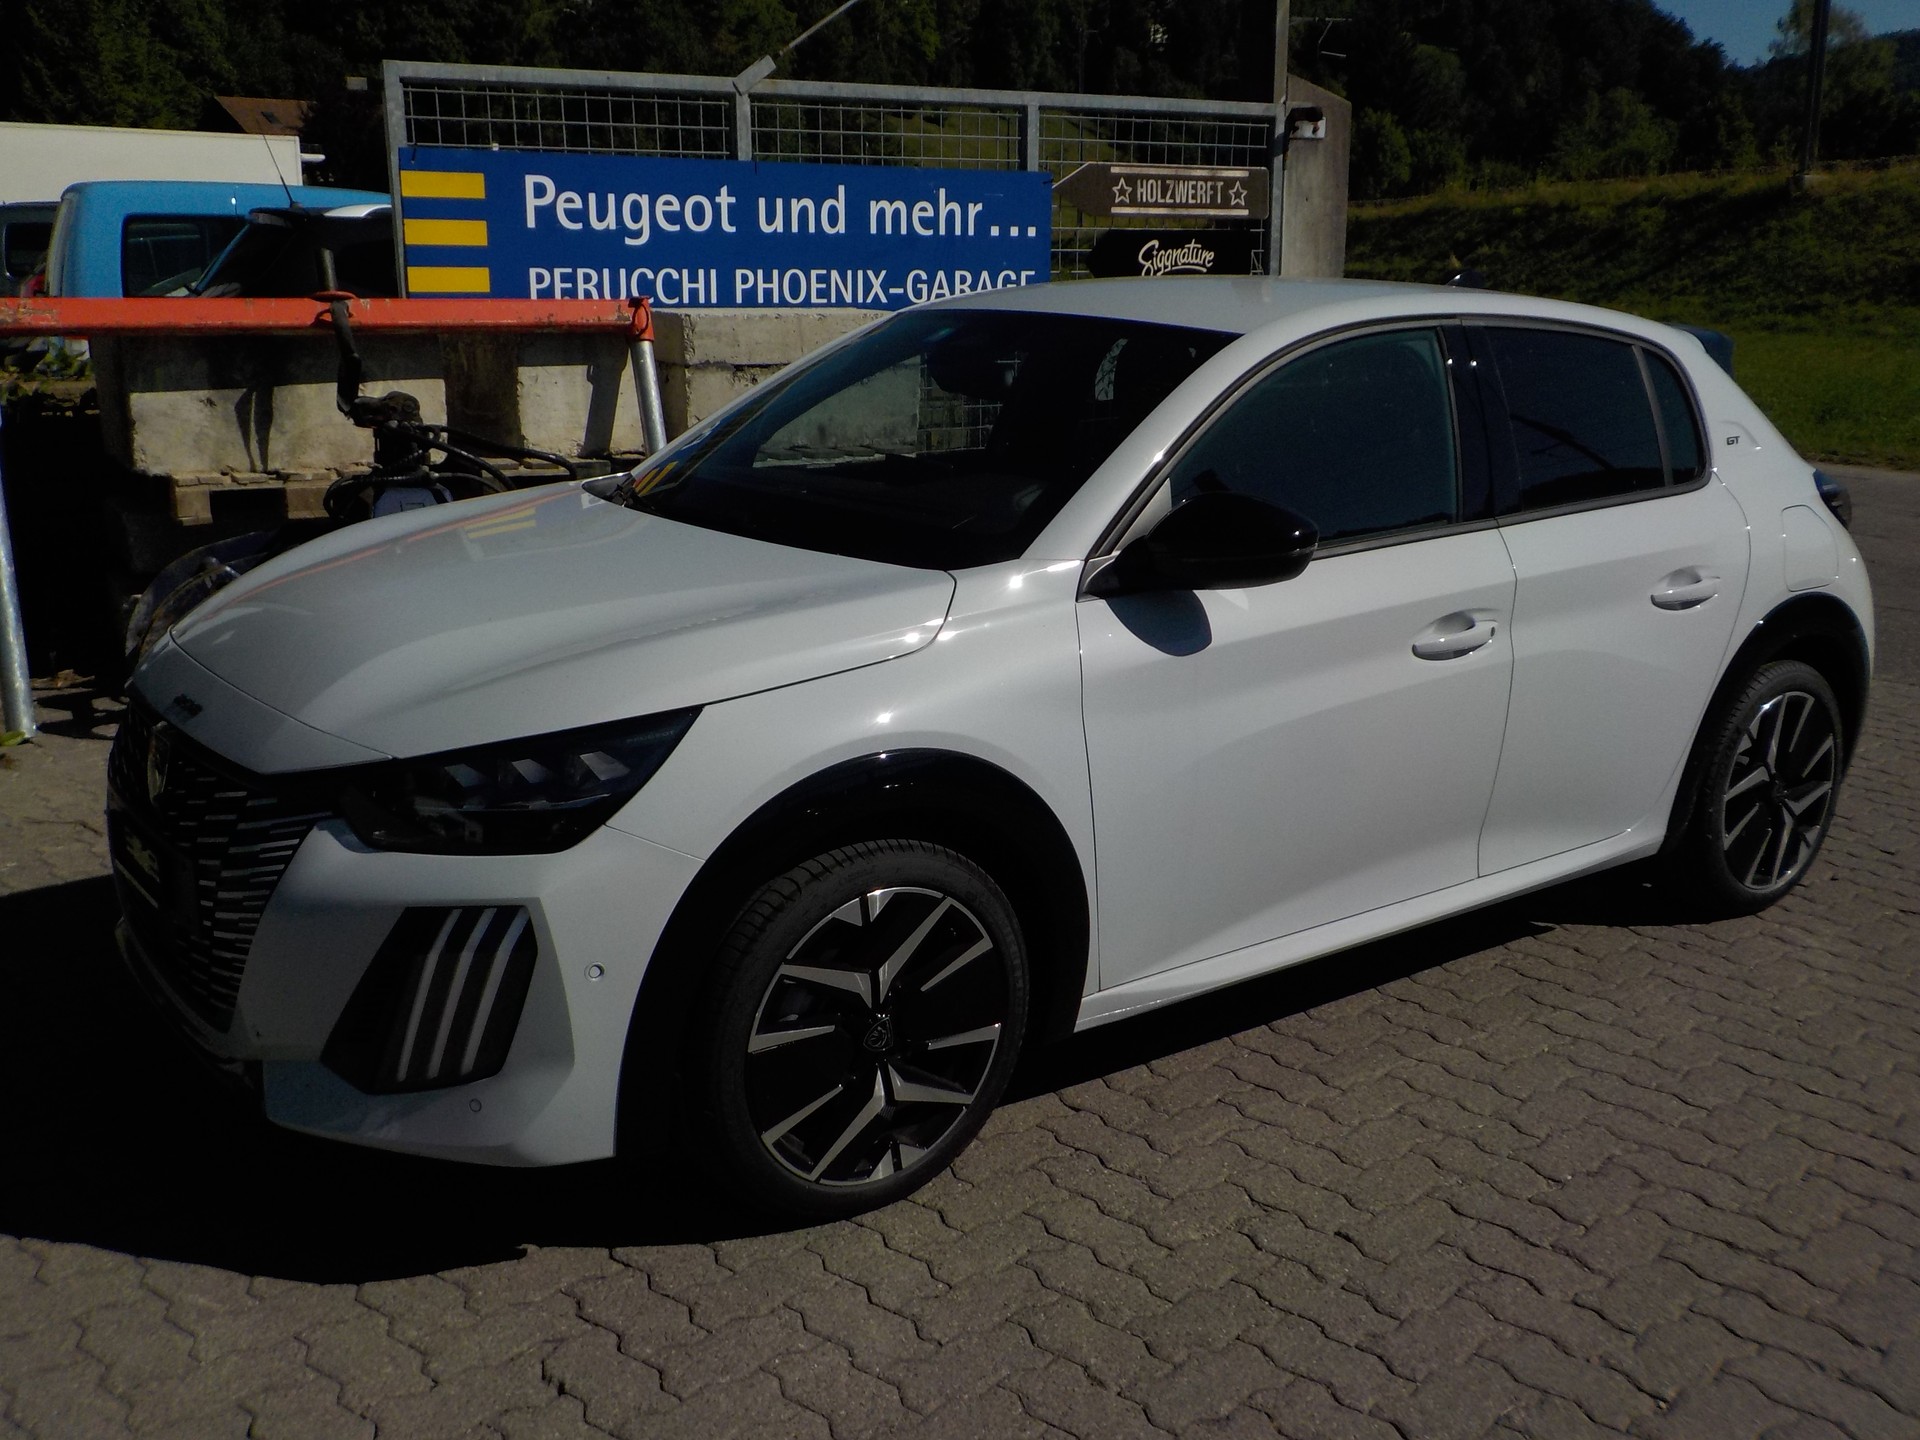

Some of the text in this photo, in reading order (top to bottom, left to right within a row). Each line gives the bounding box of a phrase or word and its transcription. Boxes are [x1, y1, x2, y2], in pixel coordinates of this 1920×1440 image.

[524, 174, 1037, 246] Peugeot und mehr...
[1136, 178, 1225, 205] HOLZWERFT
[1137, 237, 1216, 277] Siggnature
[528, 267, 717, 304] PERUCCHI
[1726, 435, 1740, 446] GT
